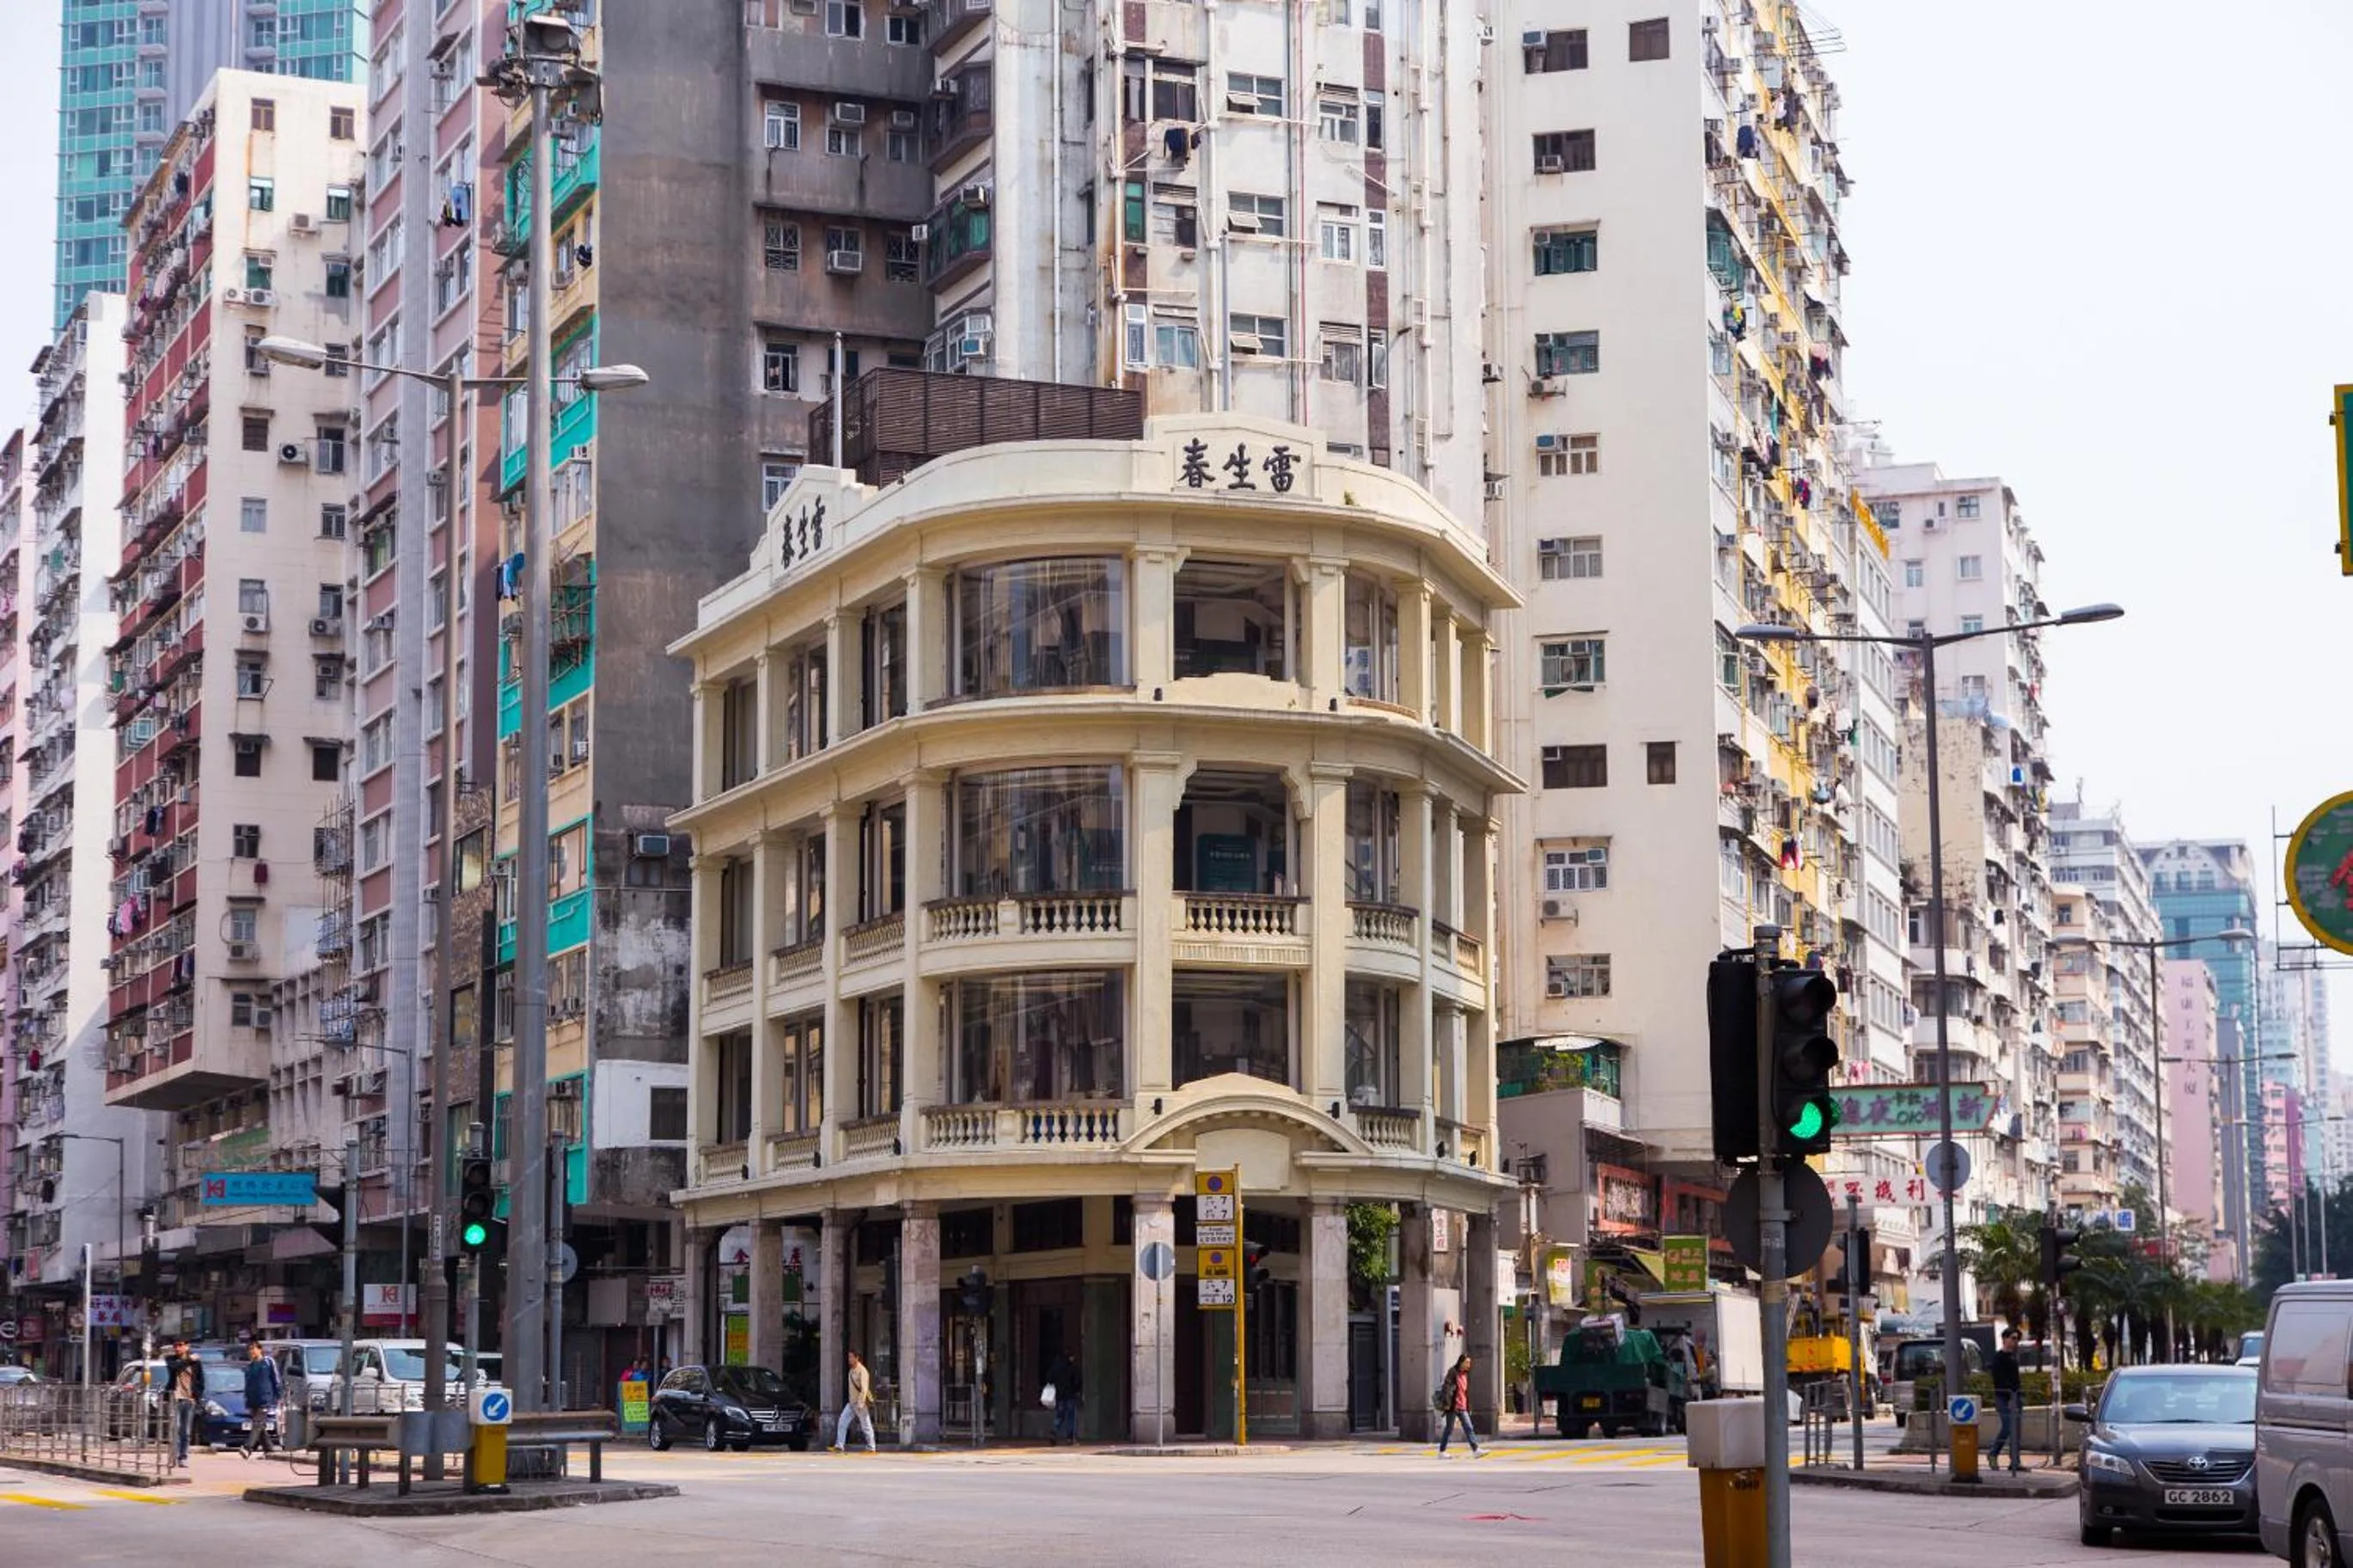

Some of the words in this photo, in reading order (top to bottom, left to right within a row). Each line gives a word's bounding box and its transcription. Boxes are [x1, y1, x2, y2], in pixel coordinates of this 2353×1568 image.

[1220, 1196, 1227, 1205] 7
[1219, 1210, 1227, 1218] 7
[1221, 1280, 1227, 1290] 7
[1222, 1293, 1233, 1303] 12
[2168, 1491, 2187, 1503] GC
[2191, 1491, 2231, 1503] 2862
